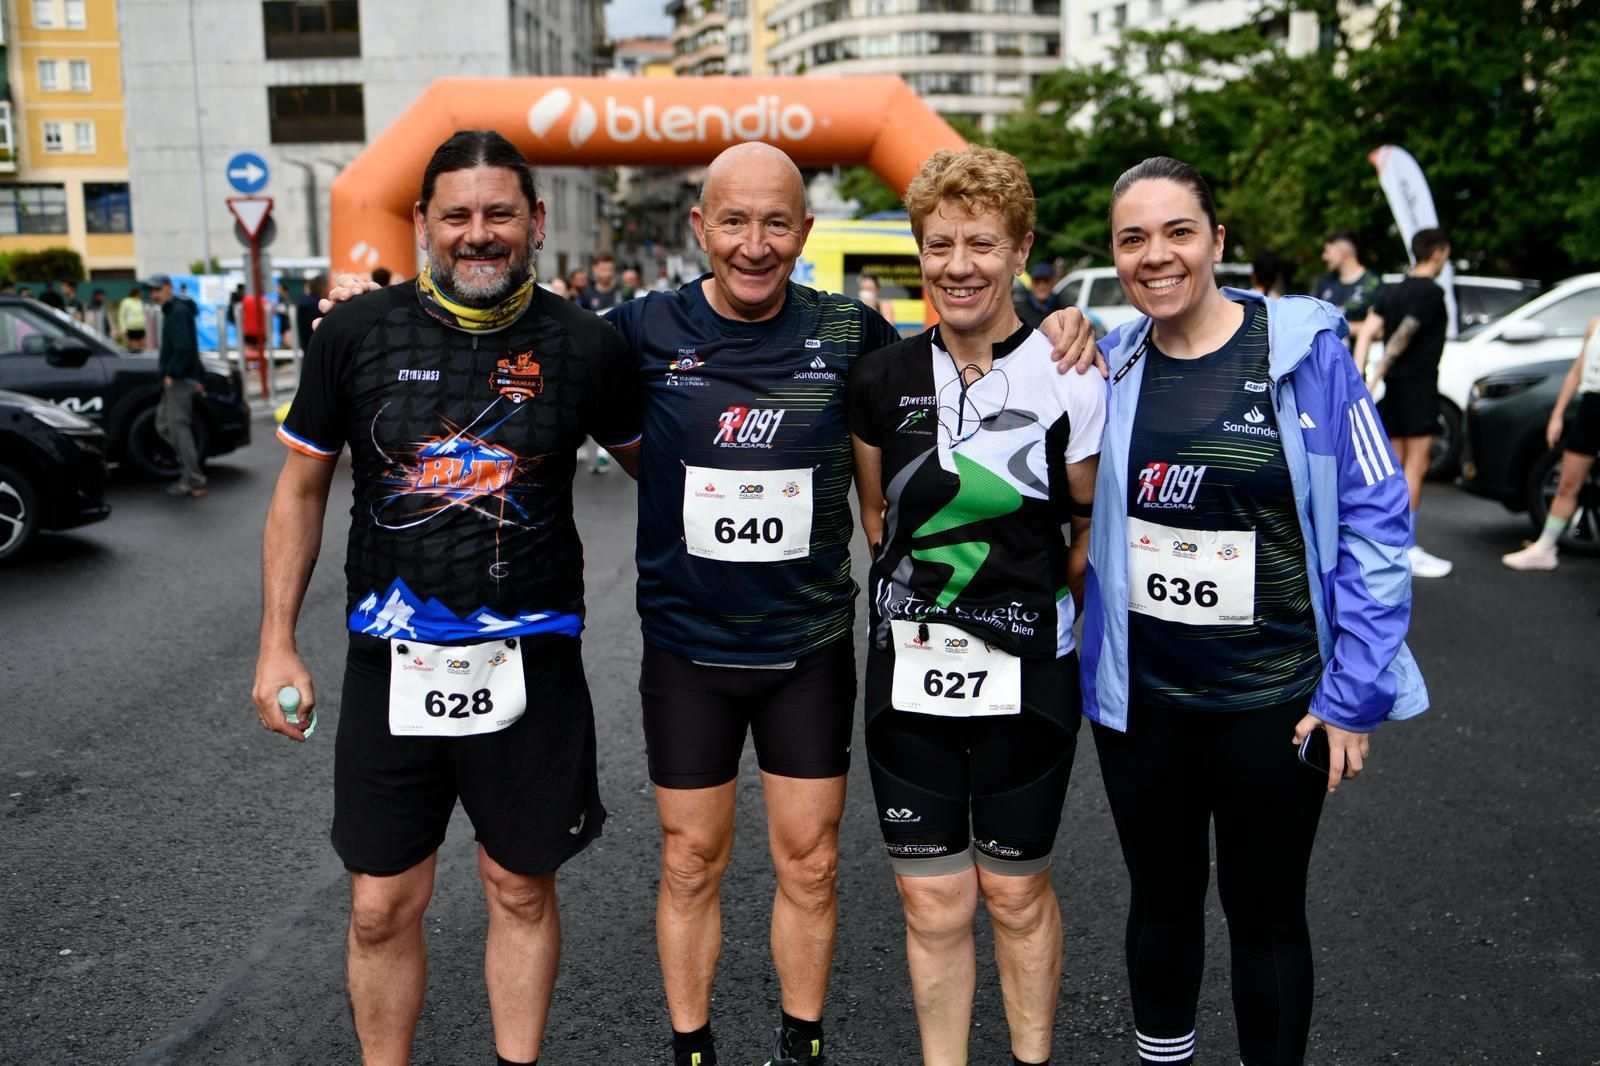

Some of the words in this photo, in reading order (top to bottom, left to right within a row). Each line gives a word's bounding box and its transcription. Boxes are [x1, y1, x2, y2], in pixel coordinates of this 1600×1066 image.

[605, 96, 814, 142] blendio
[793, 371, 837, 380] Santander
[736, 409, 785, 443] 091
[1223, 421, 1279, 439] Santander
[1158, 464, 1207, 504] 091
[695, 491, 725, 499] Santander
[1143, 502, 1194, 511] SOLIDARIA
[714, 517, 783, 544] 640
[1130, 541, 1159, 553] Santander
[1147, 573, 1218, 607] 636
[1011, 622, 1034, 636] bien
[904, 642, 933, 651] Santander
[403, 664, 434, 672] Santander
[924, 669, 988, 699] 627
[425, 688, 493, 718] 628
